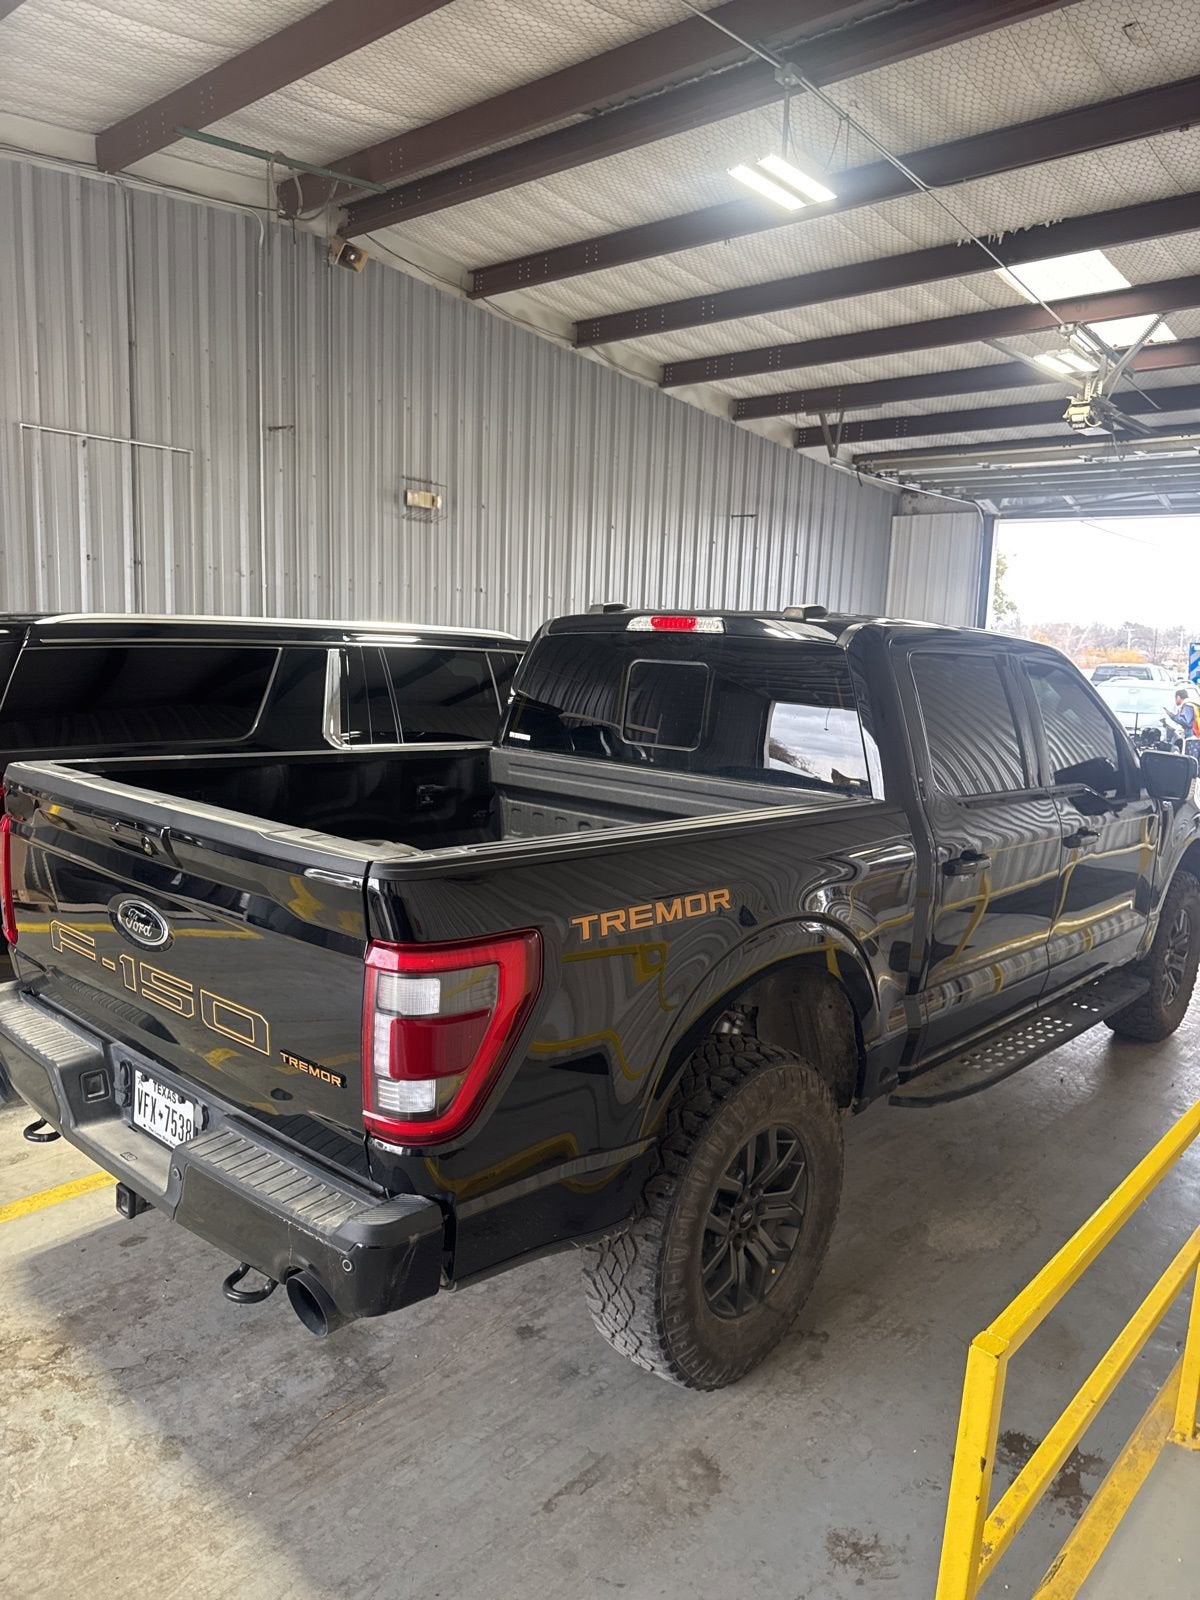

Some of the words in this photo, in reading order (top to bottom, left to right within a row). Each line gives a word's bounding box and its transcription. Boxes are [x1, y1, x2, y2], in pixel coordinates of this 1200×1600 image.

[125, 908, 153, 937] Ford
[571, 888, 731, 941] TREMOR
[50, 919, 270, 1056] F-150
[279, 1051, 342, 1088] TREMOR
[153, 1081, 177, 1104] TEXAS
